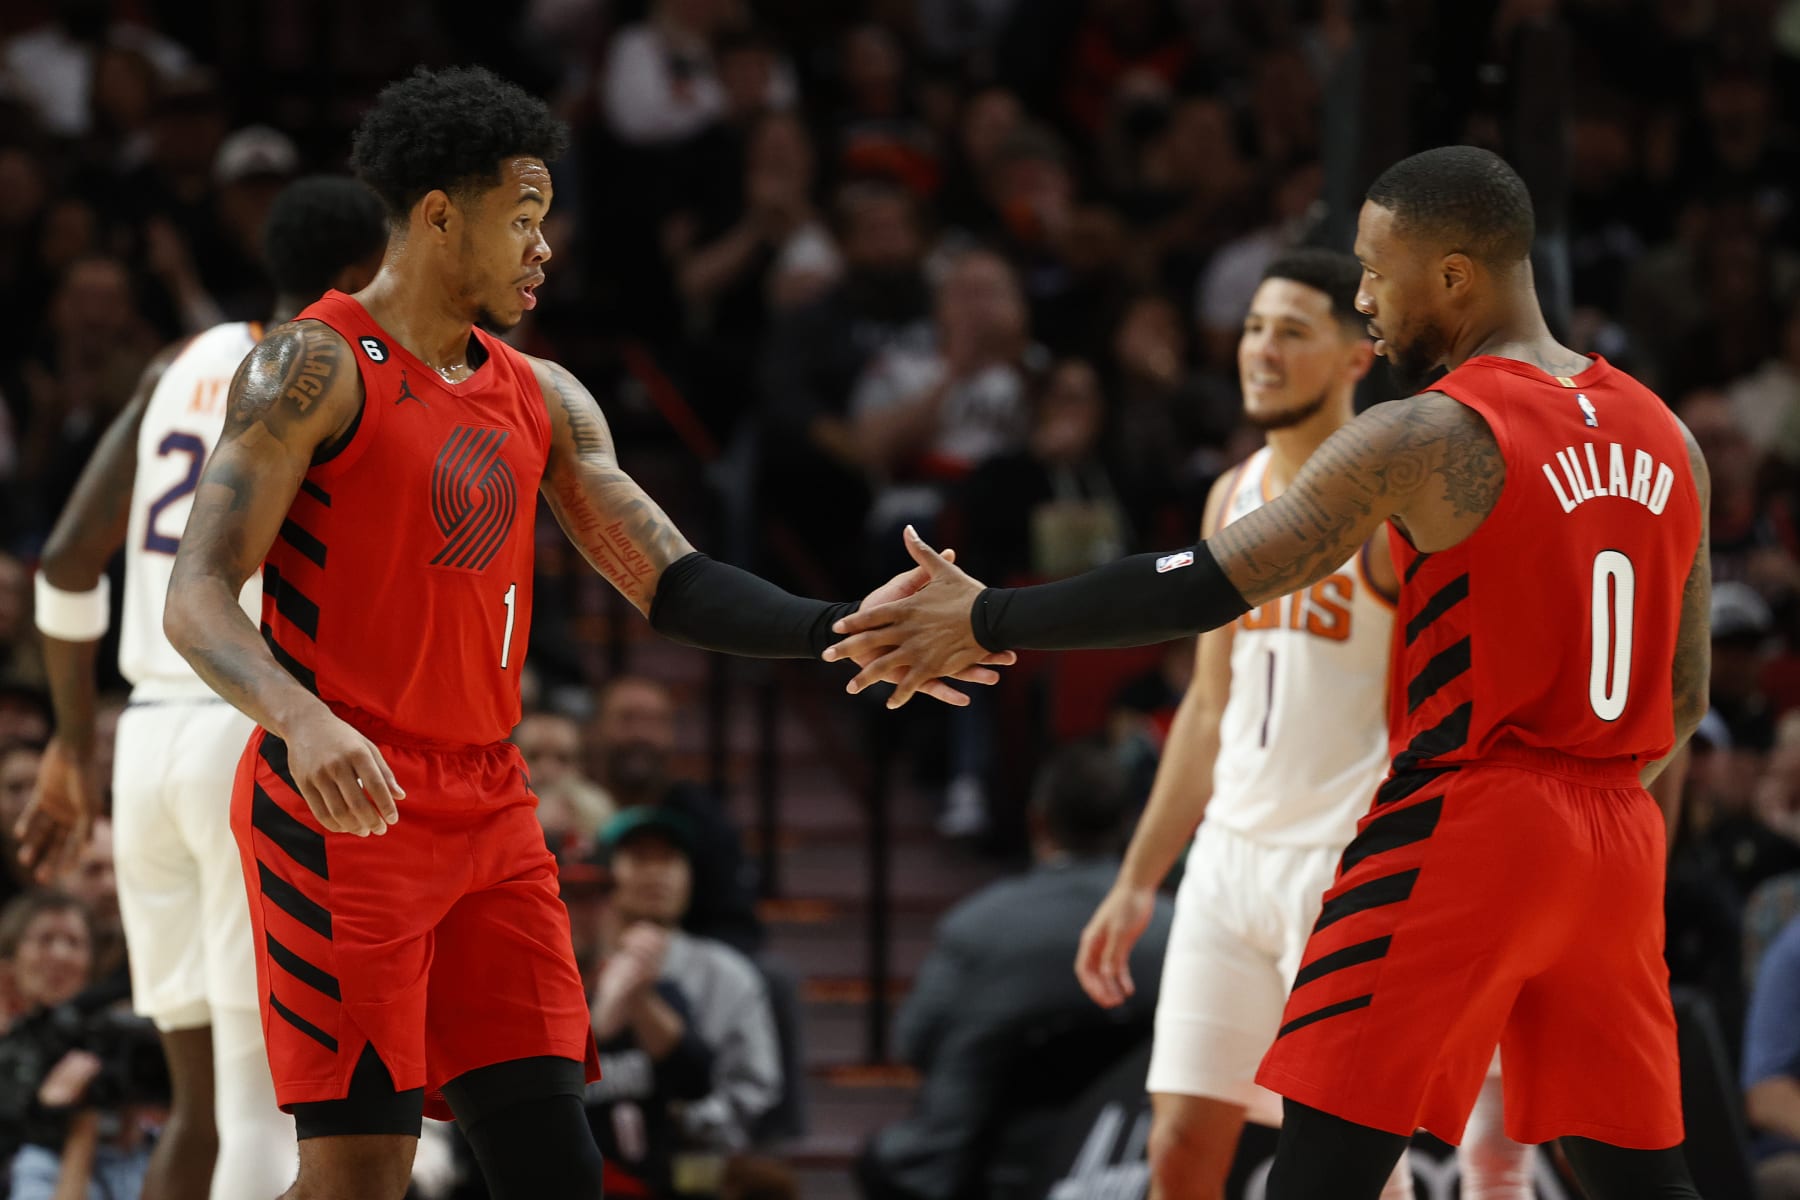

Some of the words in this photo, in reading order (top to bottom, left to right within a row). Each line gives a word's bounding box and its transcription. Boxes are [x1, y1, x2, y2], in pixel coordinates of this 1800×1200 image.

[361, 340, 384, 361] 6
[1541, 442, 1675, 515] LILLARD
[588, 544, 639, 597] humble
[605, 519, 655, 577] hungry
[501, 582, 517, 670] 1
[1589, 548, 1636, 722] 0
